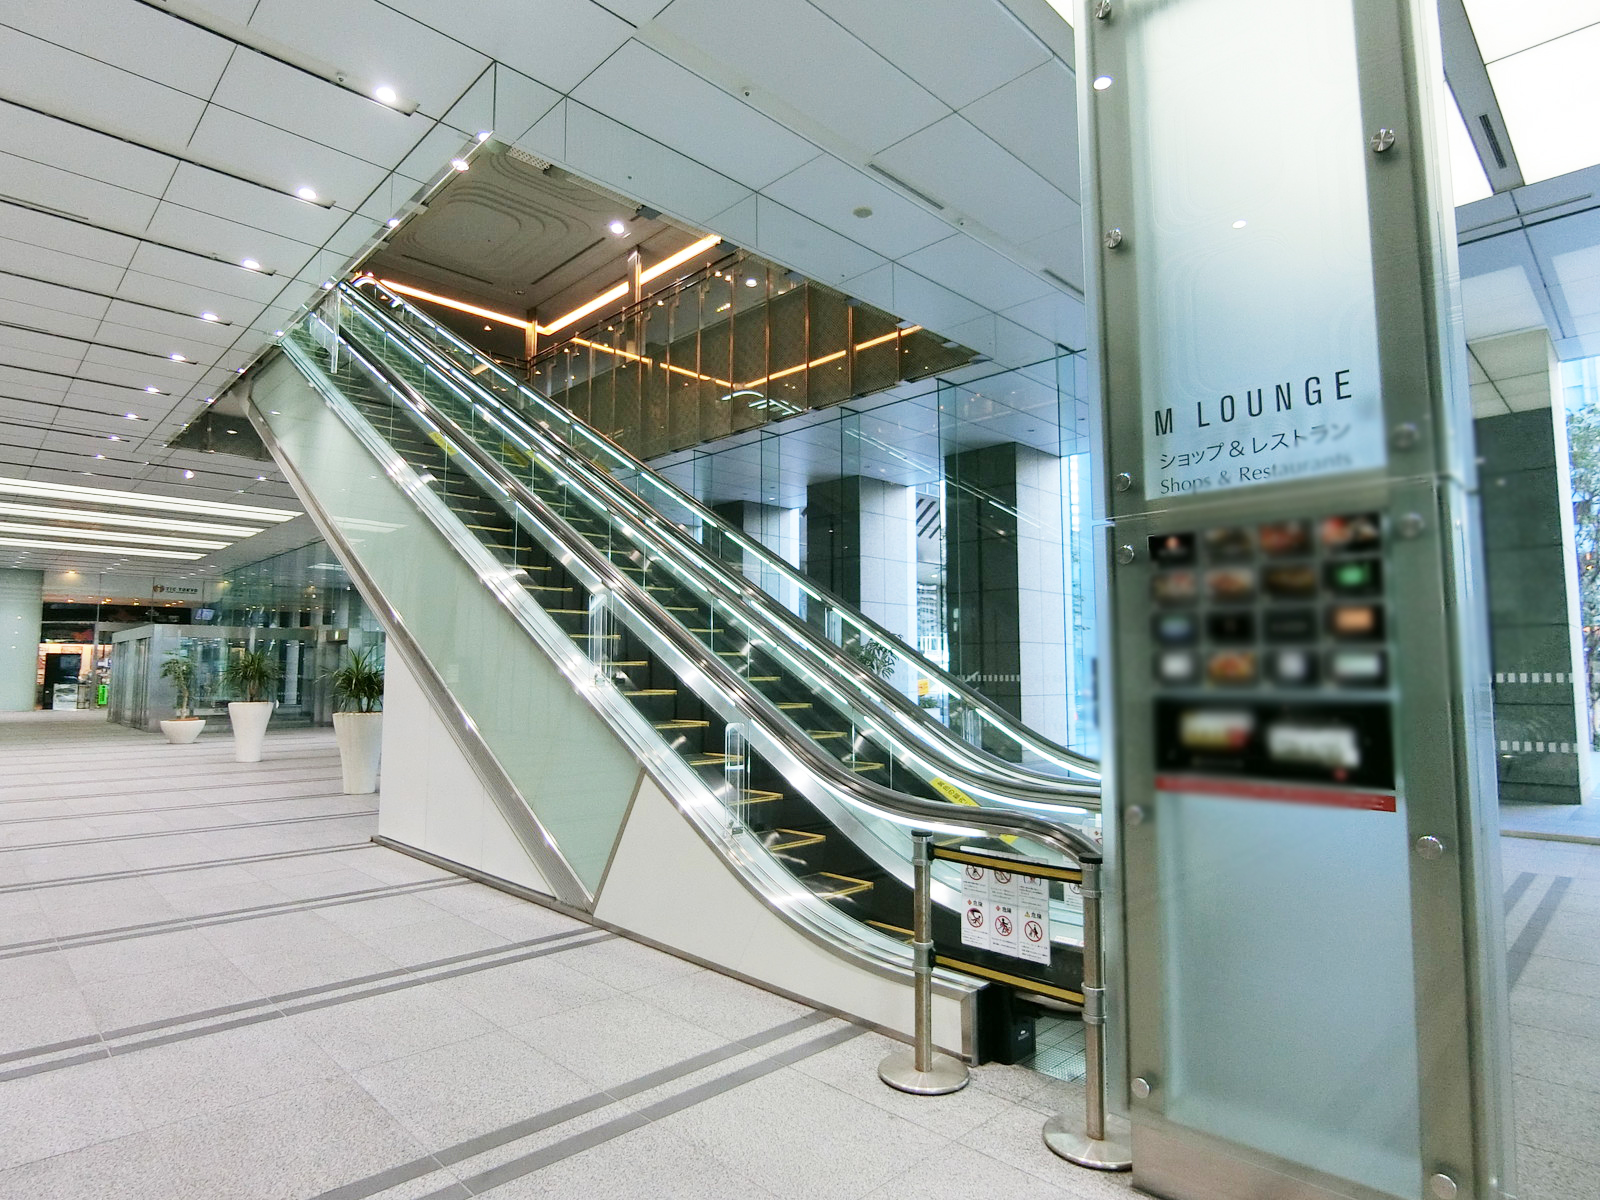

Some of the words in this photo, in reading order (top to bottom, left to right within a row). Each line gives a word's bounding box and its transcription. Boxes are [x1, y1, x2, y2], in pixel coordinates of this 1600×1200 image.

[1154, 407, 1173, 436] M
[1197, 369, 1352, 427] LOUNGE
[1160, 475, 1211, 495] Shops
[1218, 470, 1232, 486] &
